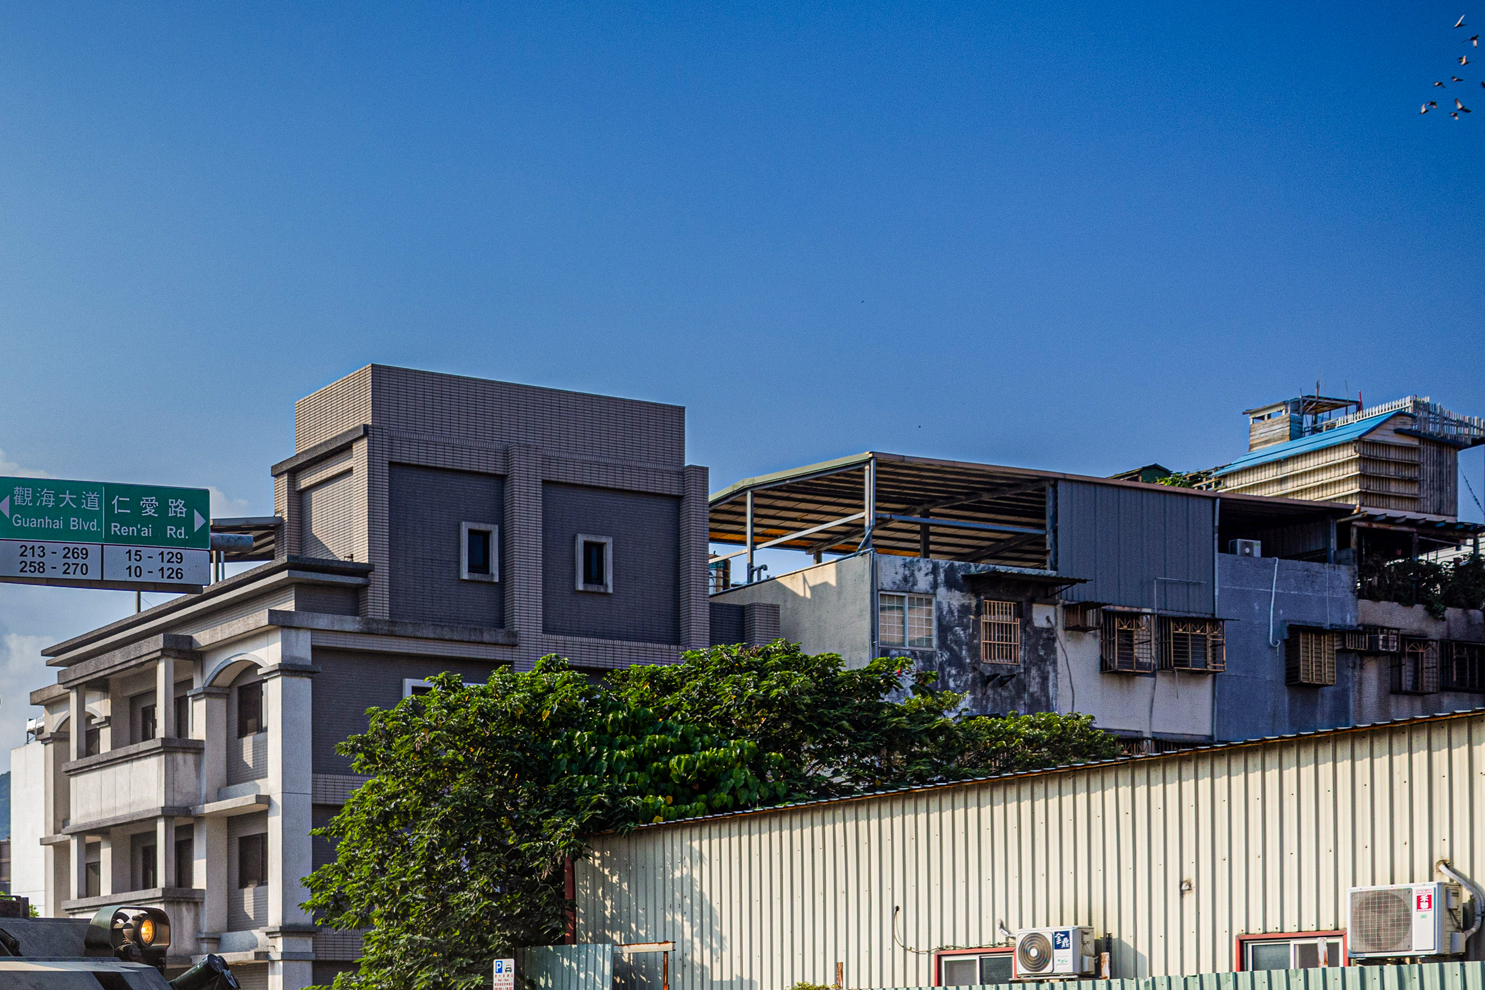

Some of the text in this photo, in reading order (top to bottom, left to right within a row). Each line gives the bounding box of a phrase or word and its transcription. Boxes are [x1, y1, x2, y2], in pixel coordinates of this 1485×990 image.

[13, 486, 100, 511] 觀海大道
[111, 495, 188, 518] 仁愛路
[12, 513, 101, 532] Guanhai Blvd.
[110, 522, 189, 539] Ren'ai Rd.
[19, 545, 46, 558] 213
[62, 547, 89, 560] 269
[125, 549, 142, 562] 15
[158, 551, 184, 564] 129
[19, 560, 46, 574] 258
[62, 562, 89, 576] 270
[125, 565, 142, 578] 10
[158, 567, 184, 580] 126
